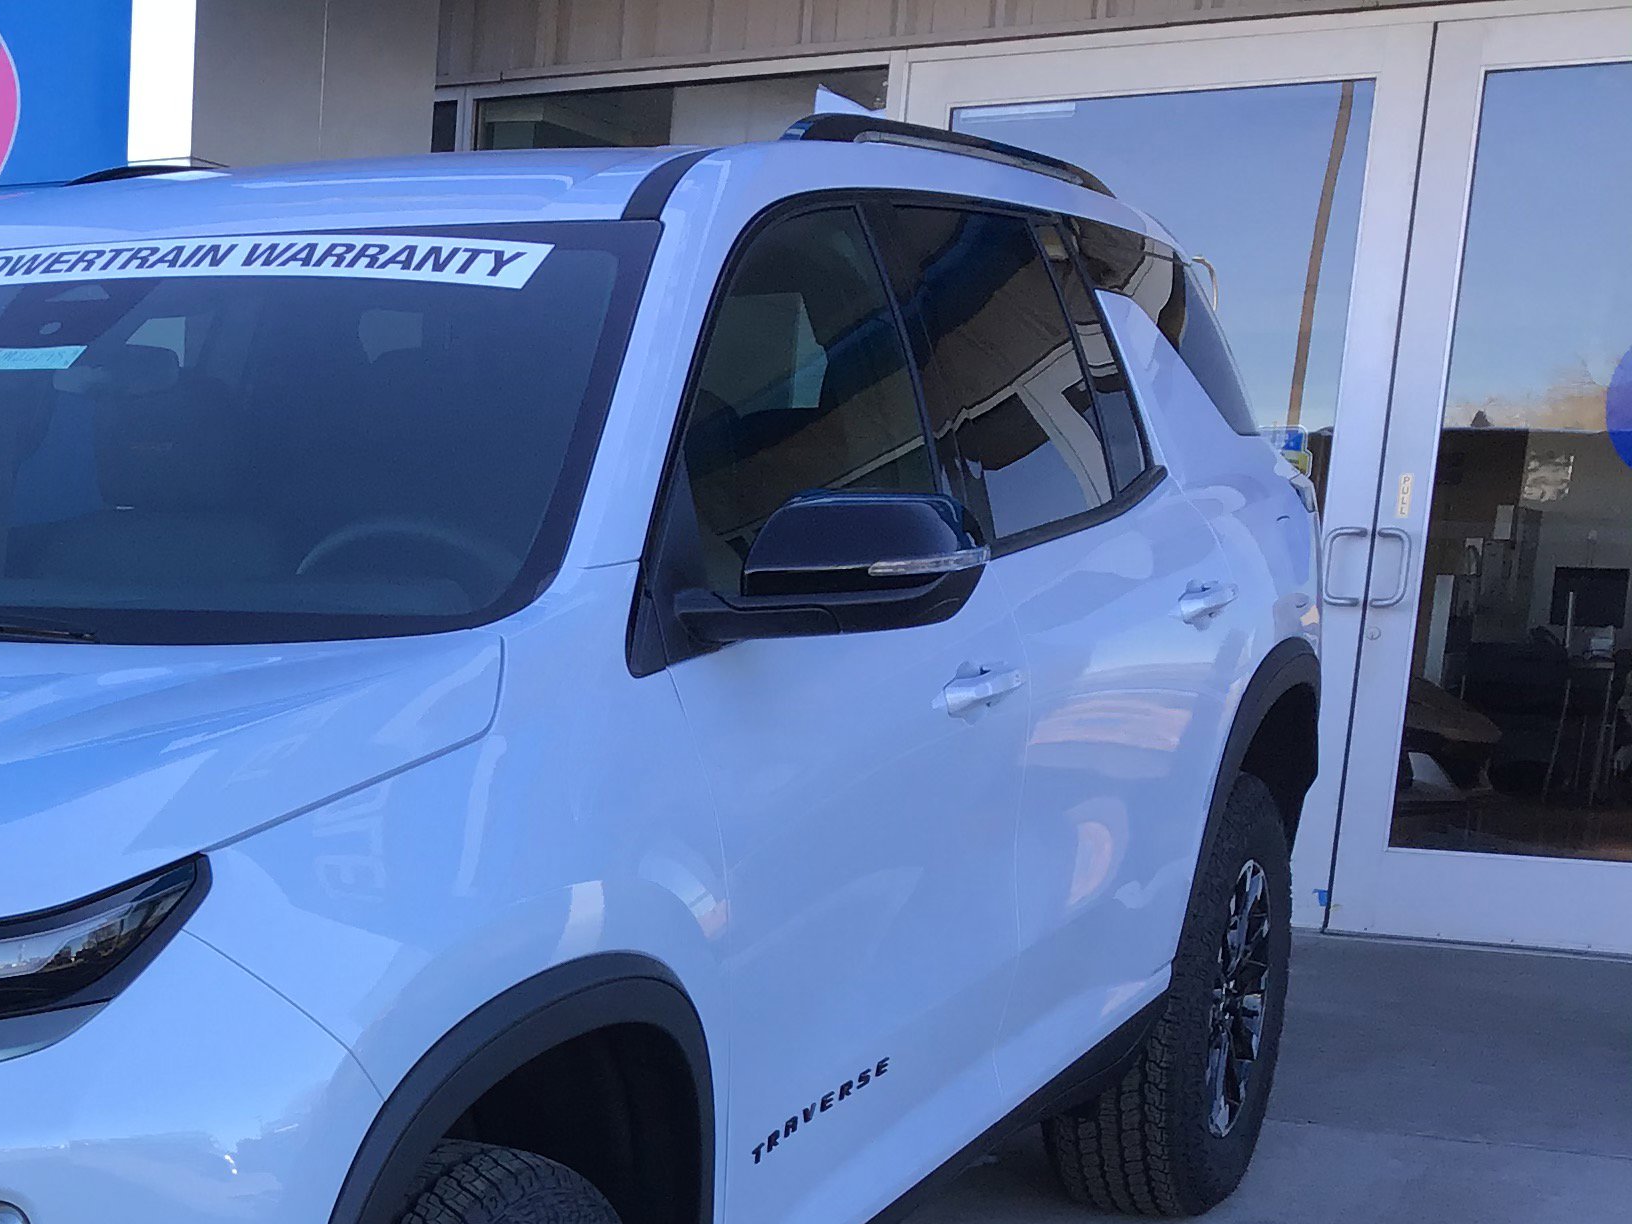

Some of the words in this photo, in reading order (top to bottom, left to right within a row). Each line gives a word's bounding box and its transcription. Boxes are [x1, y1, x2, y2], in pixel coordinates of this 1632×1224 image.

[240, 242, 528, 277] WARRANTY
[1399, 475, 1411, 515] PULL
[751, 1056, 891, 1165] TRAVERSE
